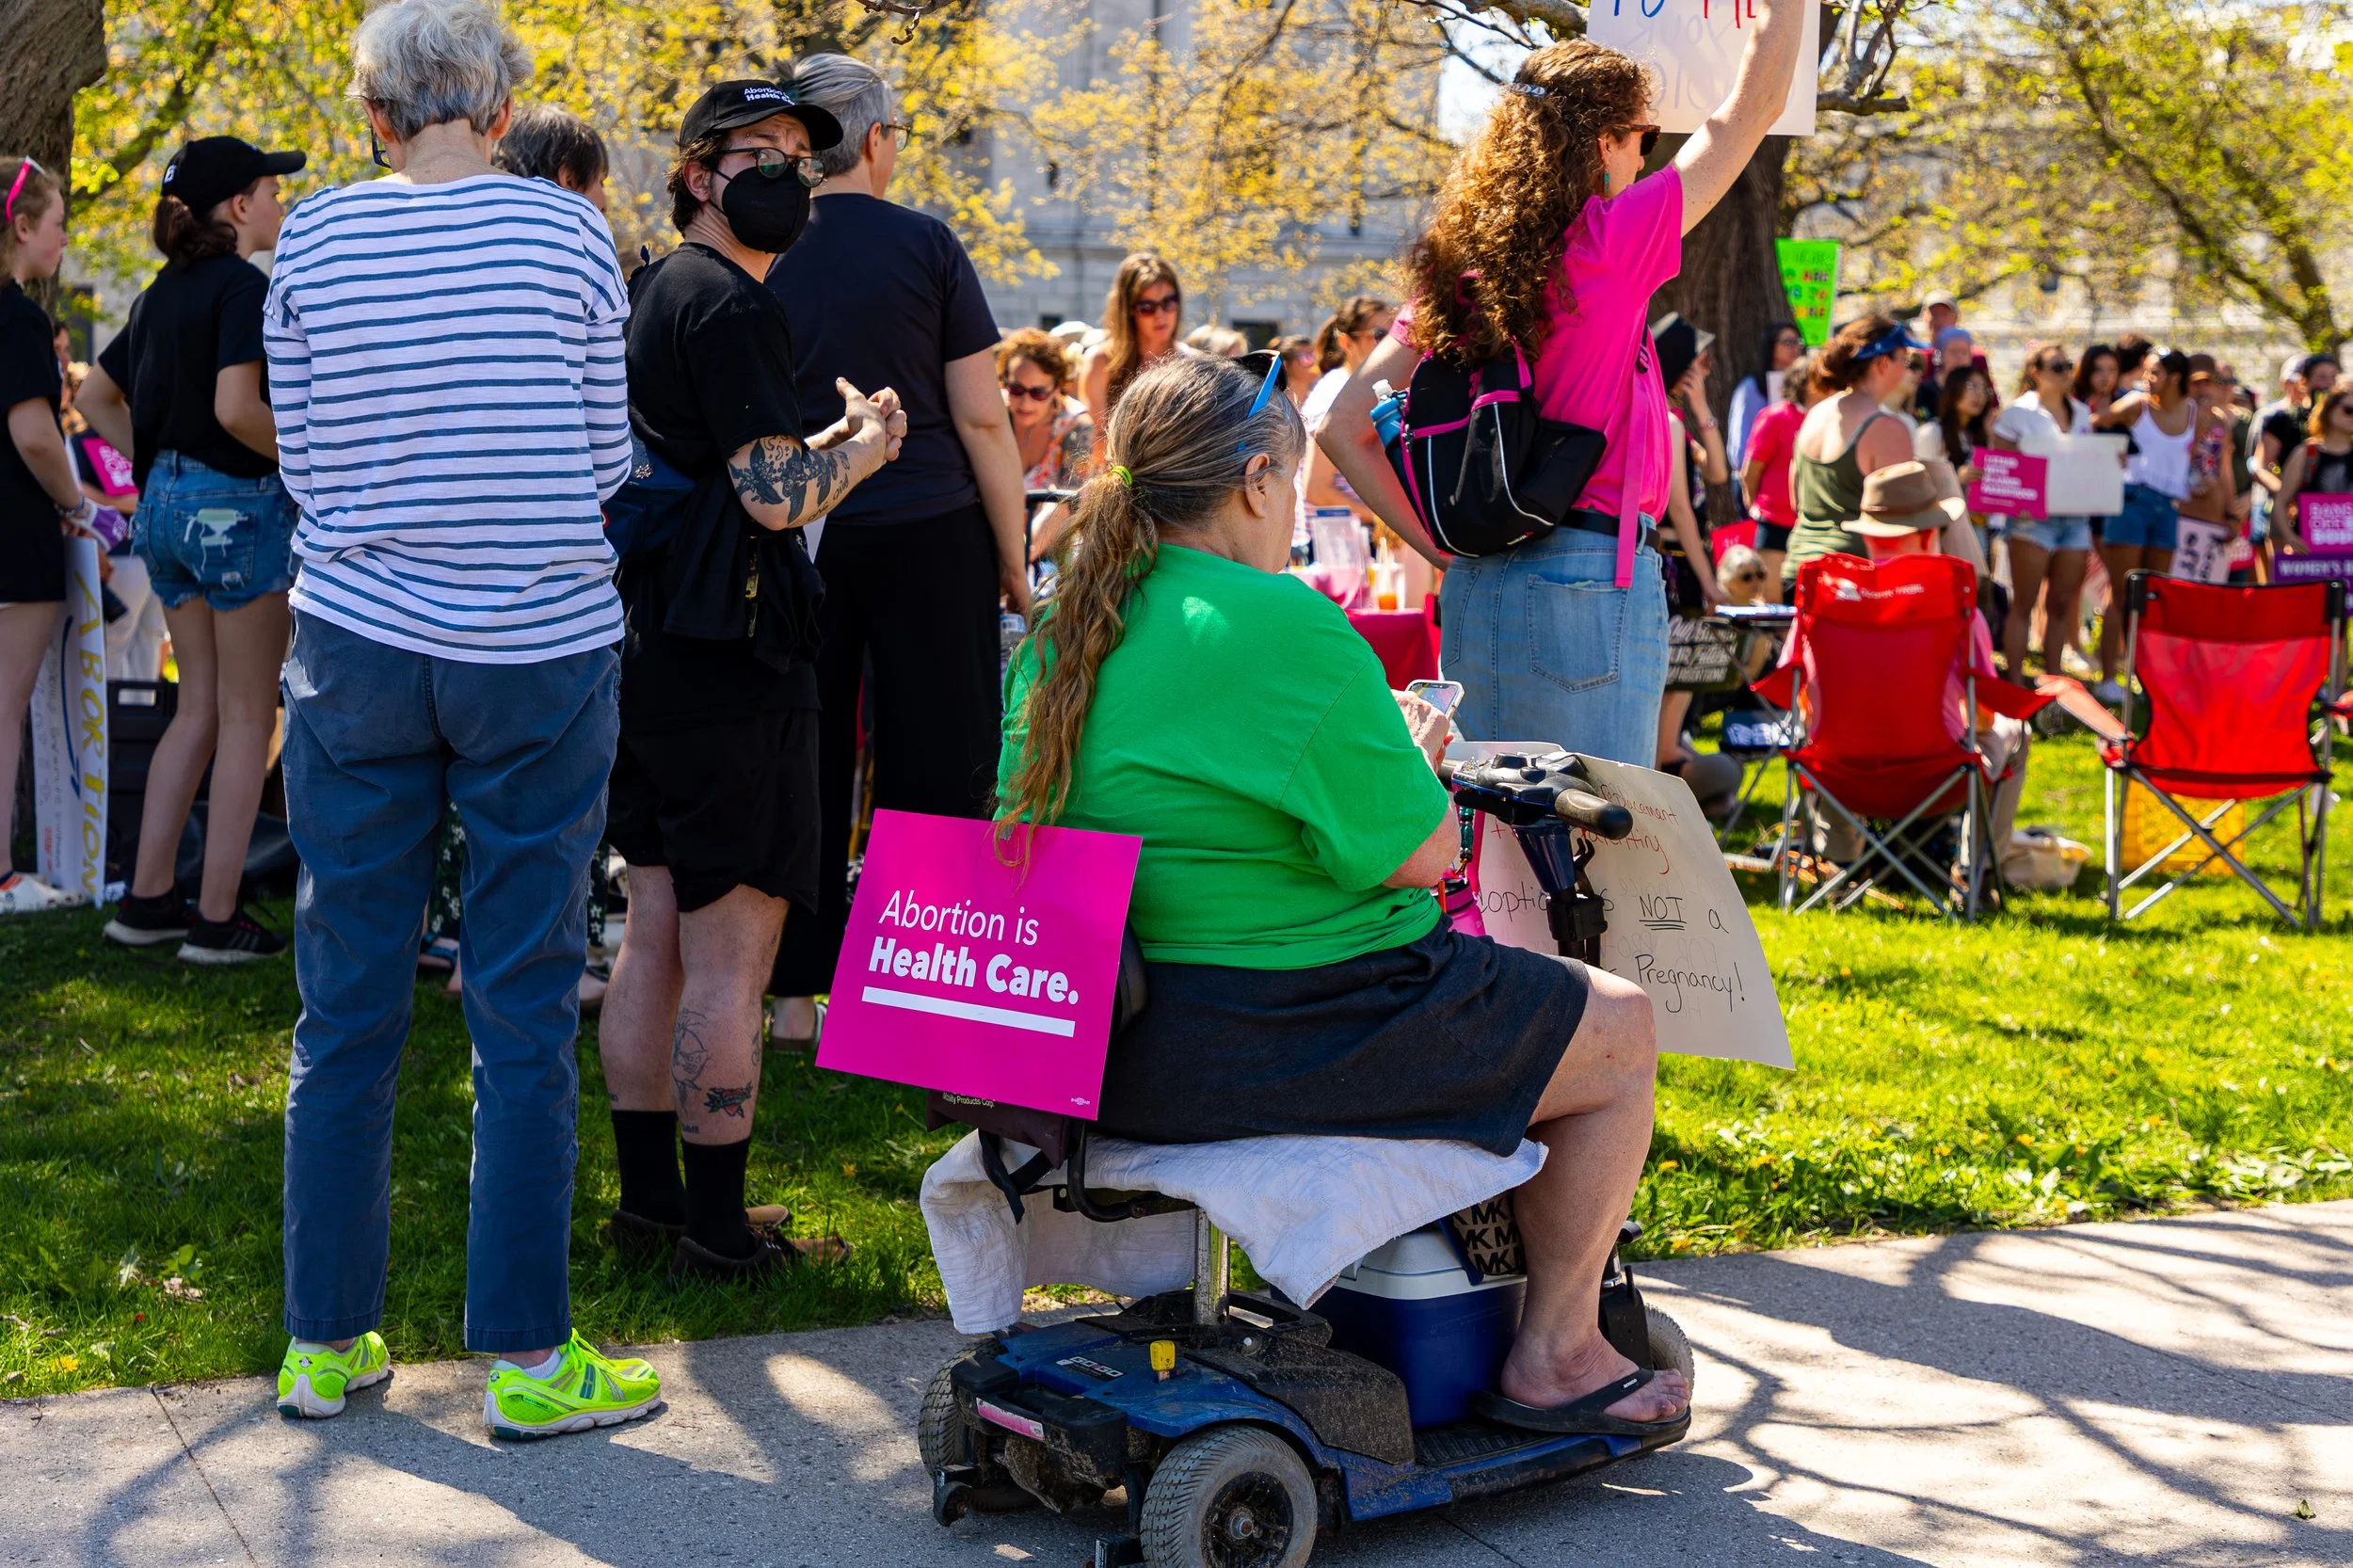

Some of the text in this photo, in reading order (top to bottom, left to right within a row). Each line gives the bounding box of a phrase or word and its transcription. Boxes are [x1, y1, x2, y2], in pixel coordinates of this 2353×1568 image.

[75, 570, 105, 893] ABORTION
[878, 889, 1039, 946] Abortion is
[1479, 880, 1549, 922] optio
[1639, 895, 1684, 922] NOT
[1707, 907, 1730, 935] a
[868, 936, 1080, 1006] Health Care.
[1634, 953, 1746, 1013] Pregnancy!
